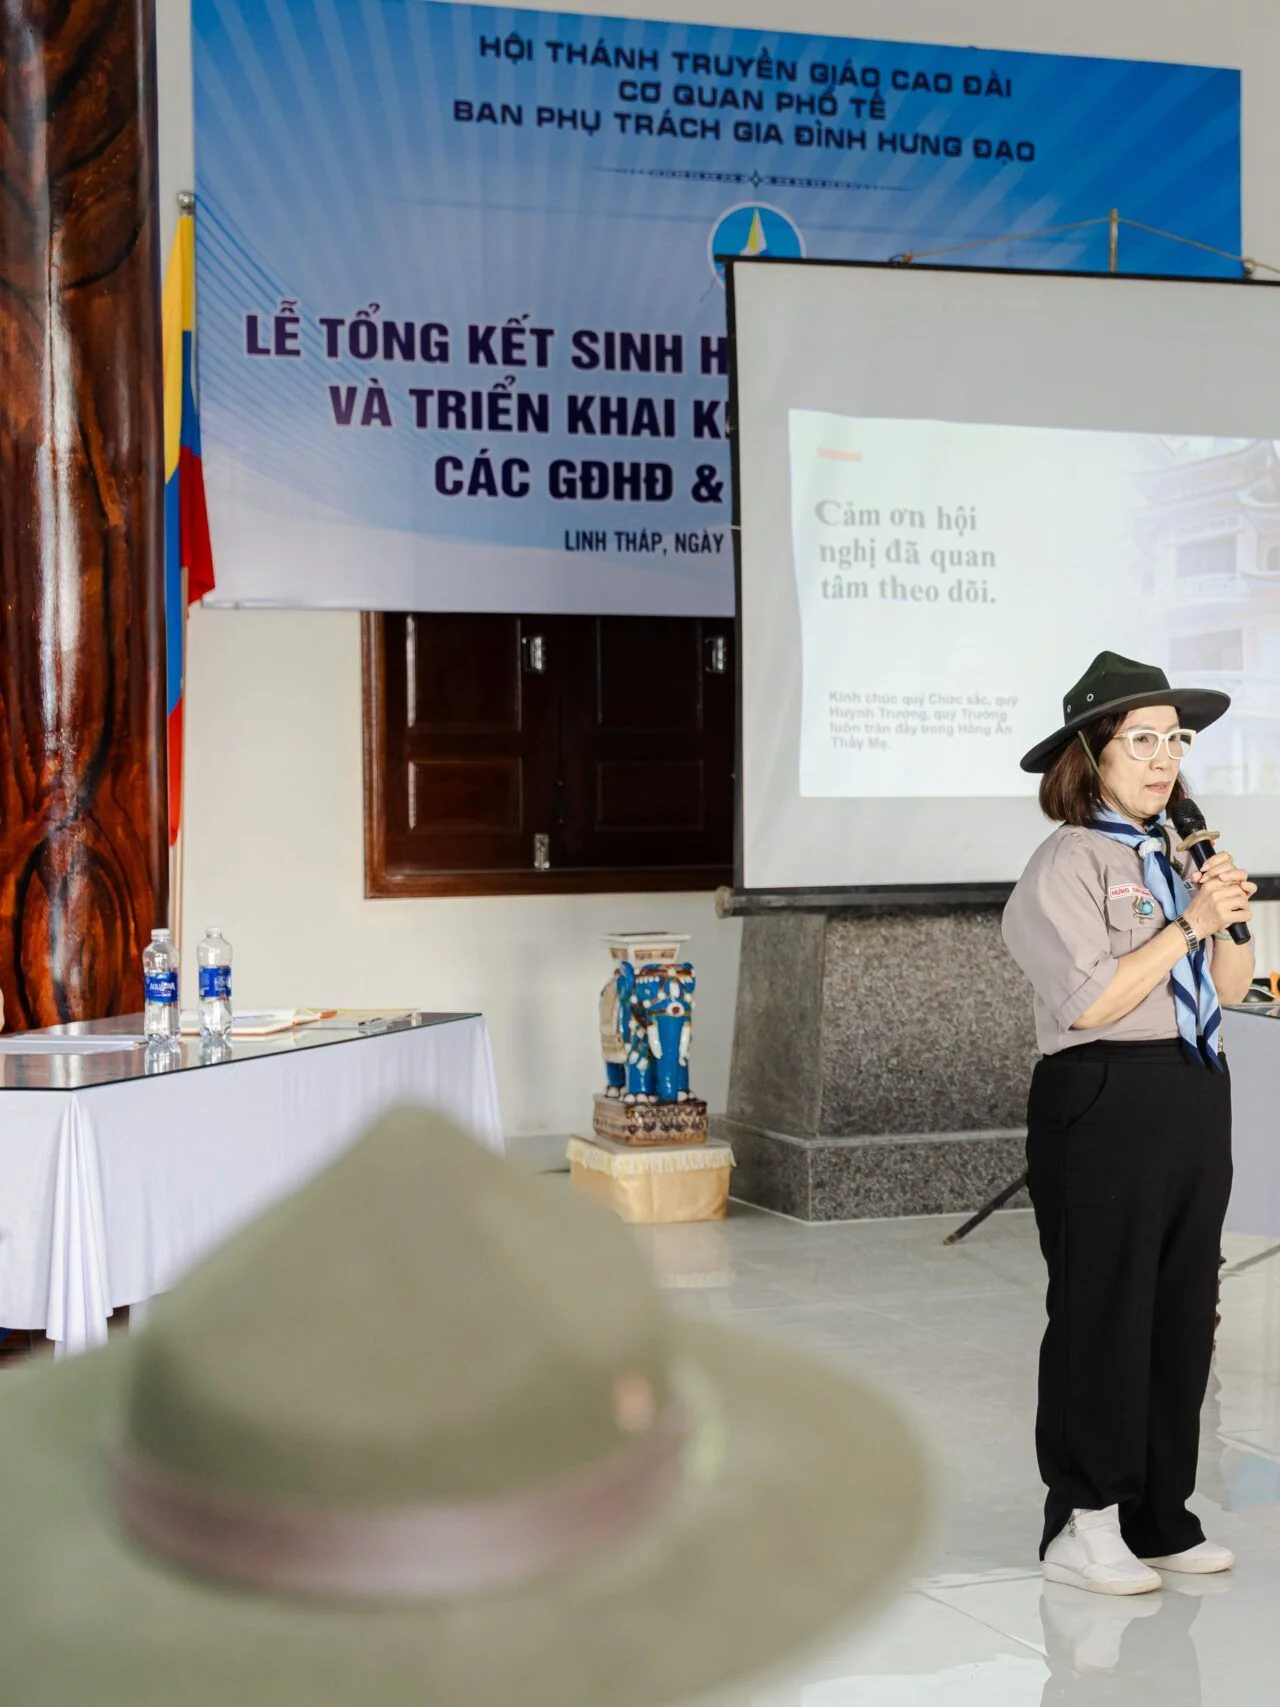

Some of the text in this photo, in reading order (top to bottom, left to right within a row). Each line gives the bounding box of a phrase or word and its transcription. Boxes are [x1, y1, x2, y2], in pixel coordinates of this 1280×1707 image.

[480, 31, 1012, 98] HỘI THÁNH TRUYỀN GIÁO CAO ĐÀI
[618, 80, 662, 104] CƠ
[673, 84, 764, 111] QUAN
[850, 89, 887, 121] TẾ
[453, 100, 1036, 165] BAN PHỤ TRÁCH GIA ĐÌNH HƯNG ĐẠO
[246, 299, 300, 357] LỄ
[319, 303, 450, 363] TỔNG
[468, 314, 554, 369] KẾT
[571, 329, 683, 375] SINH
[329, 376, 731, 440] VÀ TRIỂN KHAI K
[435, 448, 724, 503] CÁC GĐHĐ &
[565, 528, 724, 556] LINH THÁP, NGÀY
[815, 499, 977, 538] Cảm ơn hội
[819, 538, 996, 574] nghị đã quan
[821, 575, 997, 604] tâm theo dõi.
